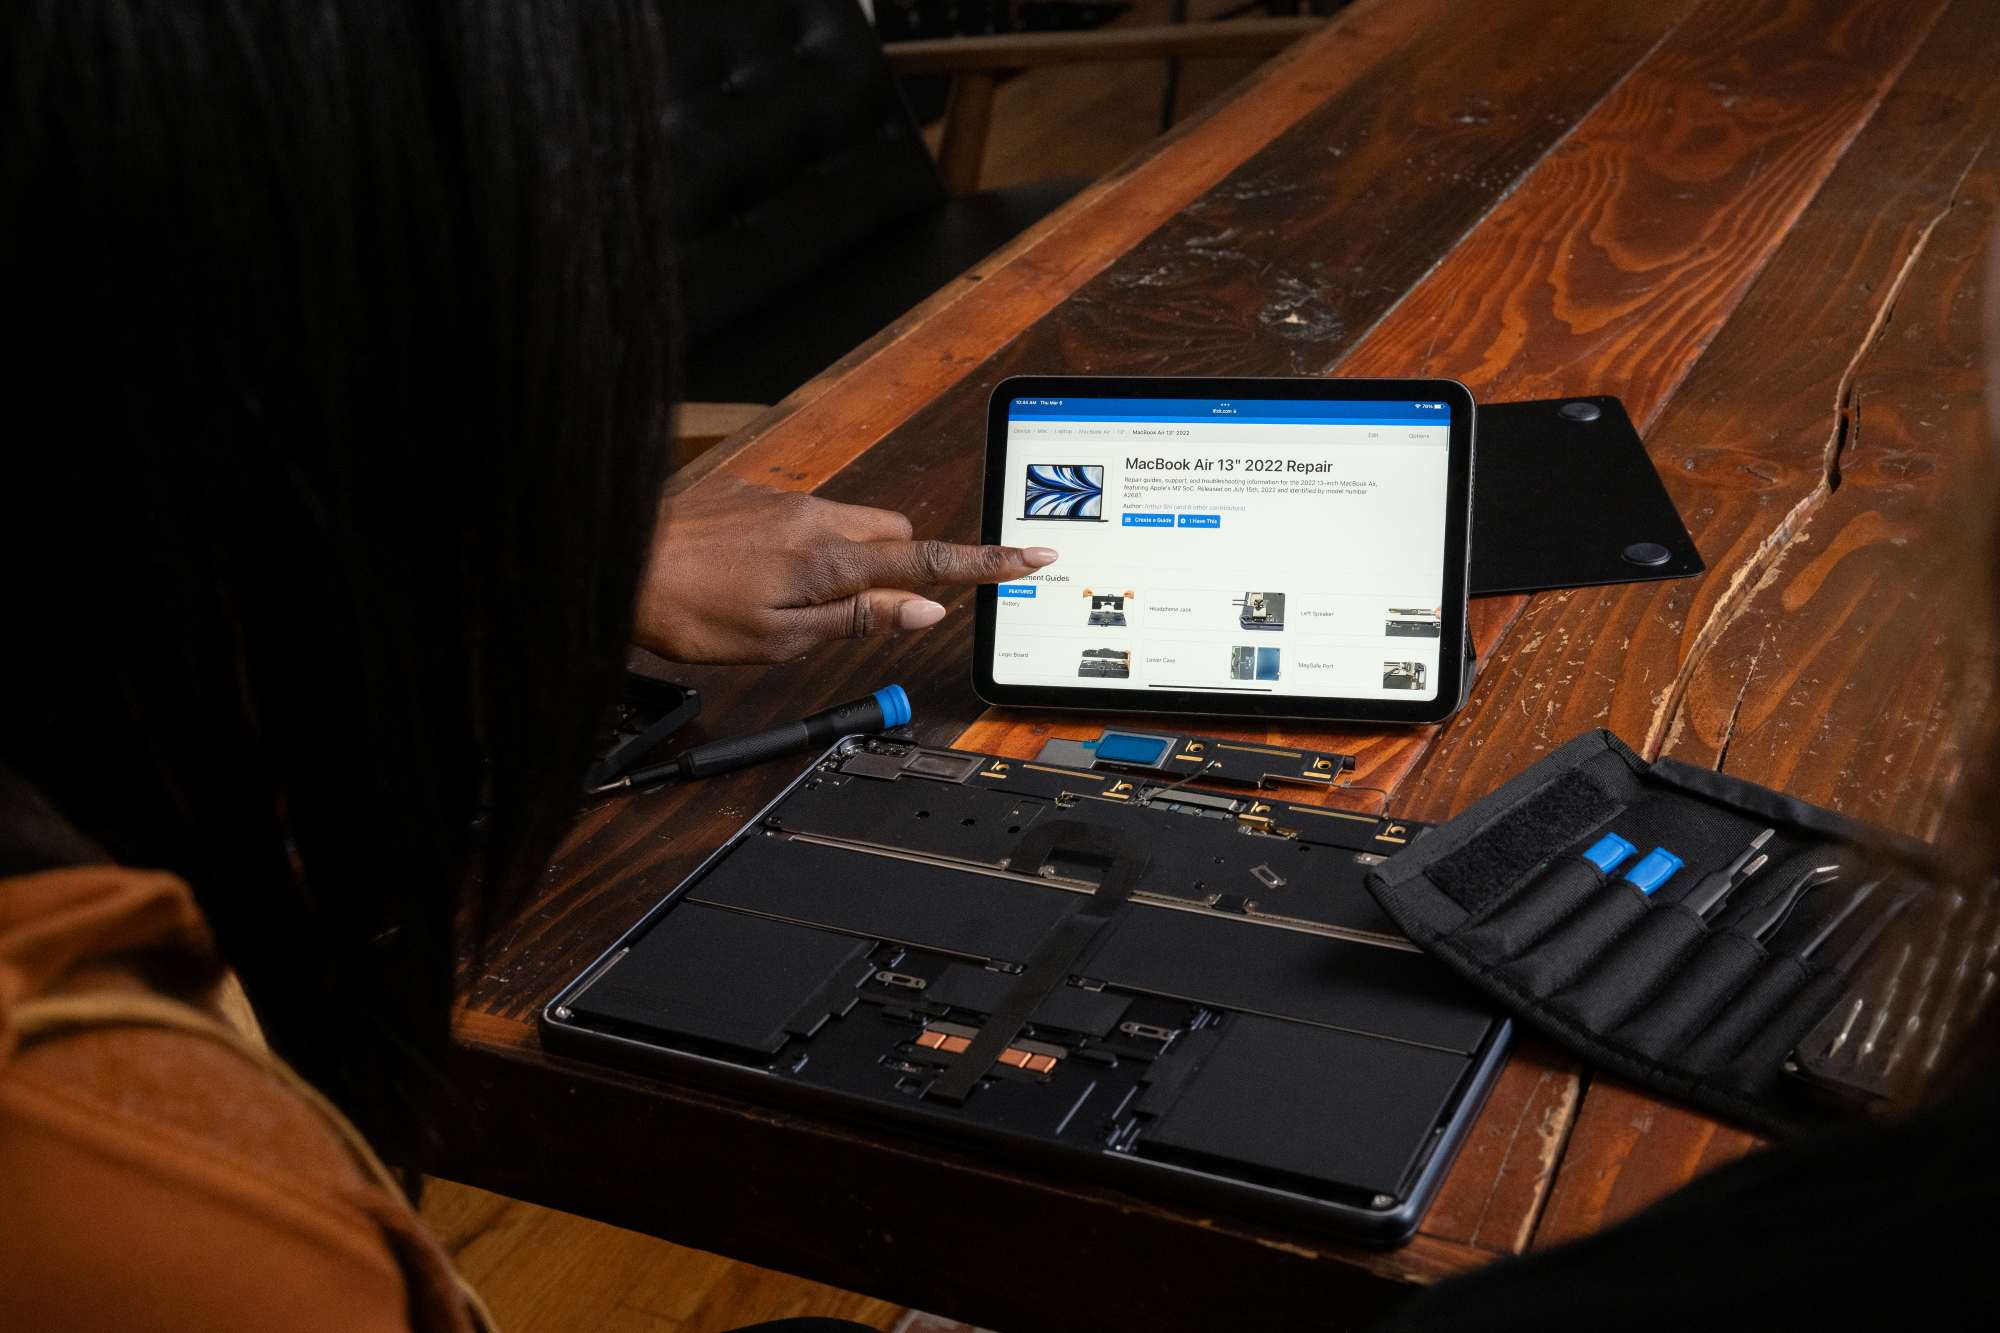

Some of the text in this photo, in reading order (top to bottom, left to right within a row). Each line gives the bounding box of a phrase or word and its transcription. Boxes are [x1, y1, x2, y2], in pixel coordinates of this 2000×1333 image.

[1125, 457, 1334, 475] MacBook Air 13" 2022 Repair
[1045, 574, 1070, 582] Guides
